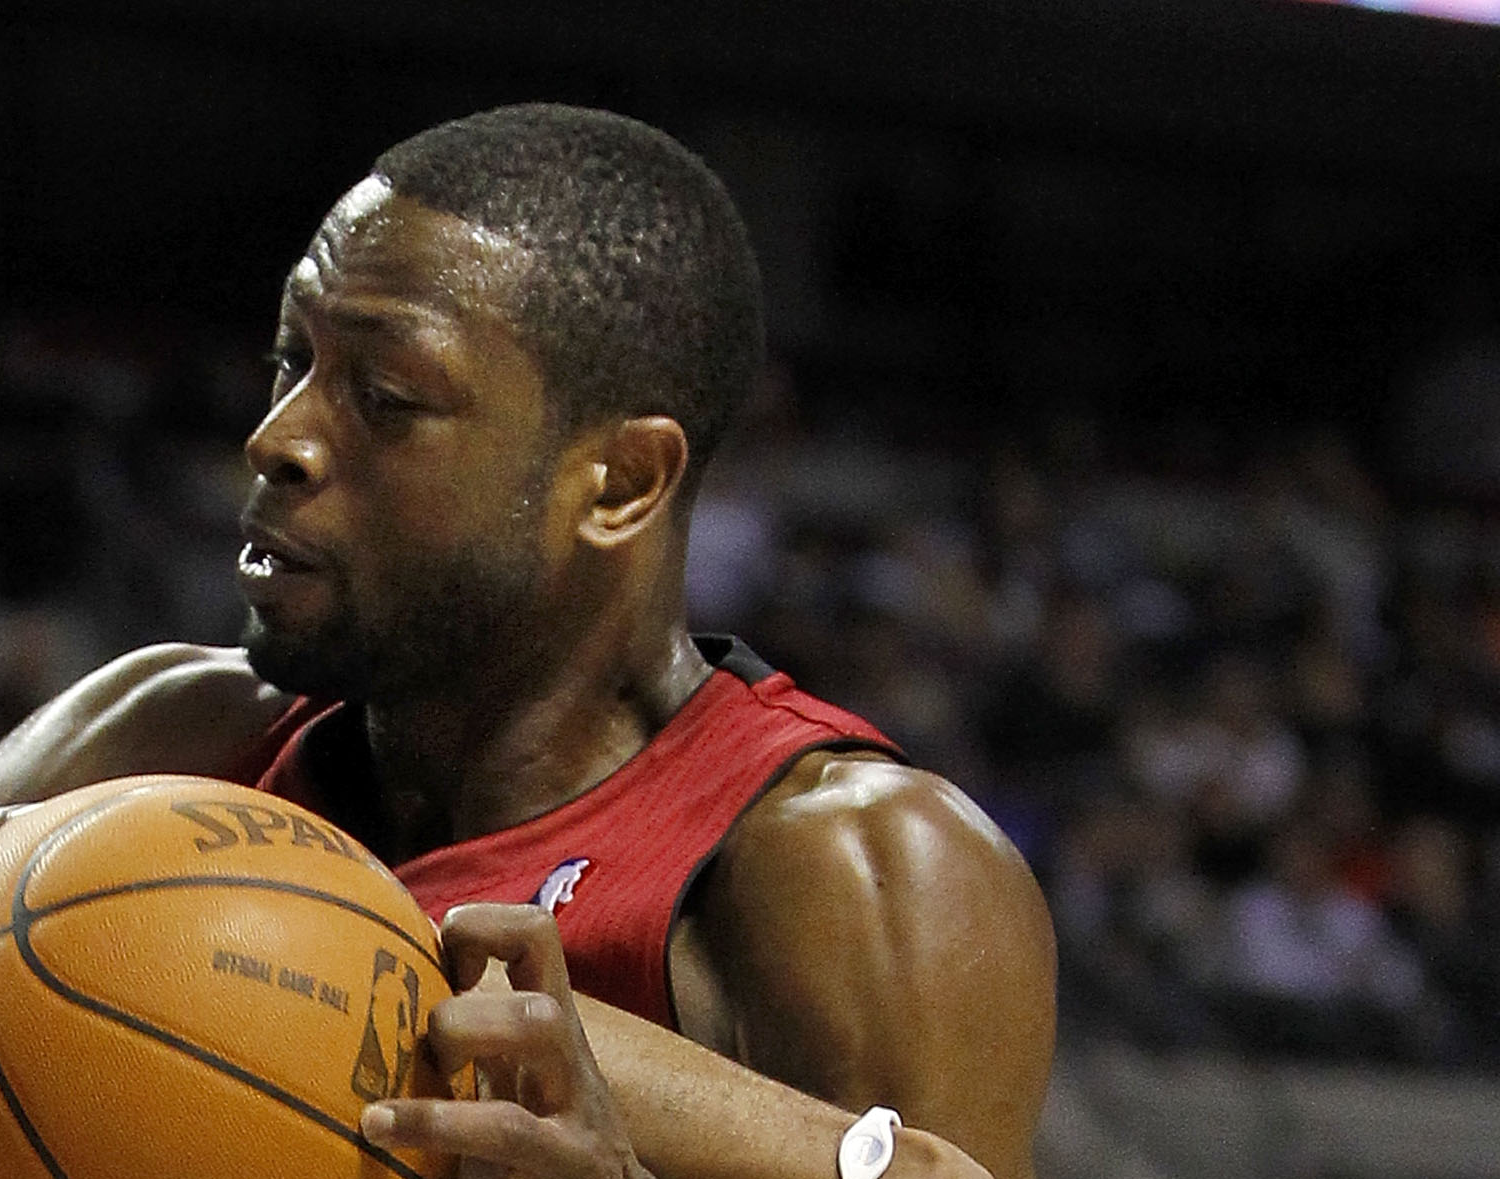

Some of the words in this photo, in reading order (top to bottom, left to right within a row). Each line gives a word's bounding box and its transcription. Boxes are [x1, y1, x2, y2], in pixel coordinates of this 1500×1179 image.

[213, 949, 271, 985] OFFICIAL
[278, 966, 316, 999] GAME
[319, 980, 349, 1015] BALL
